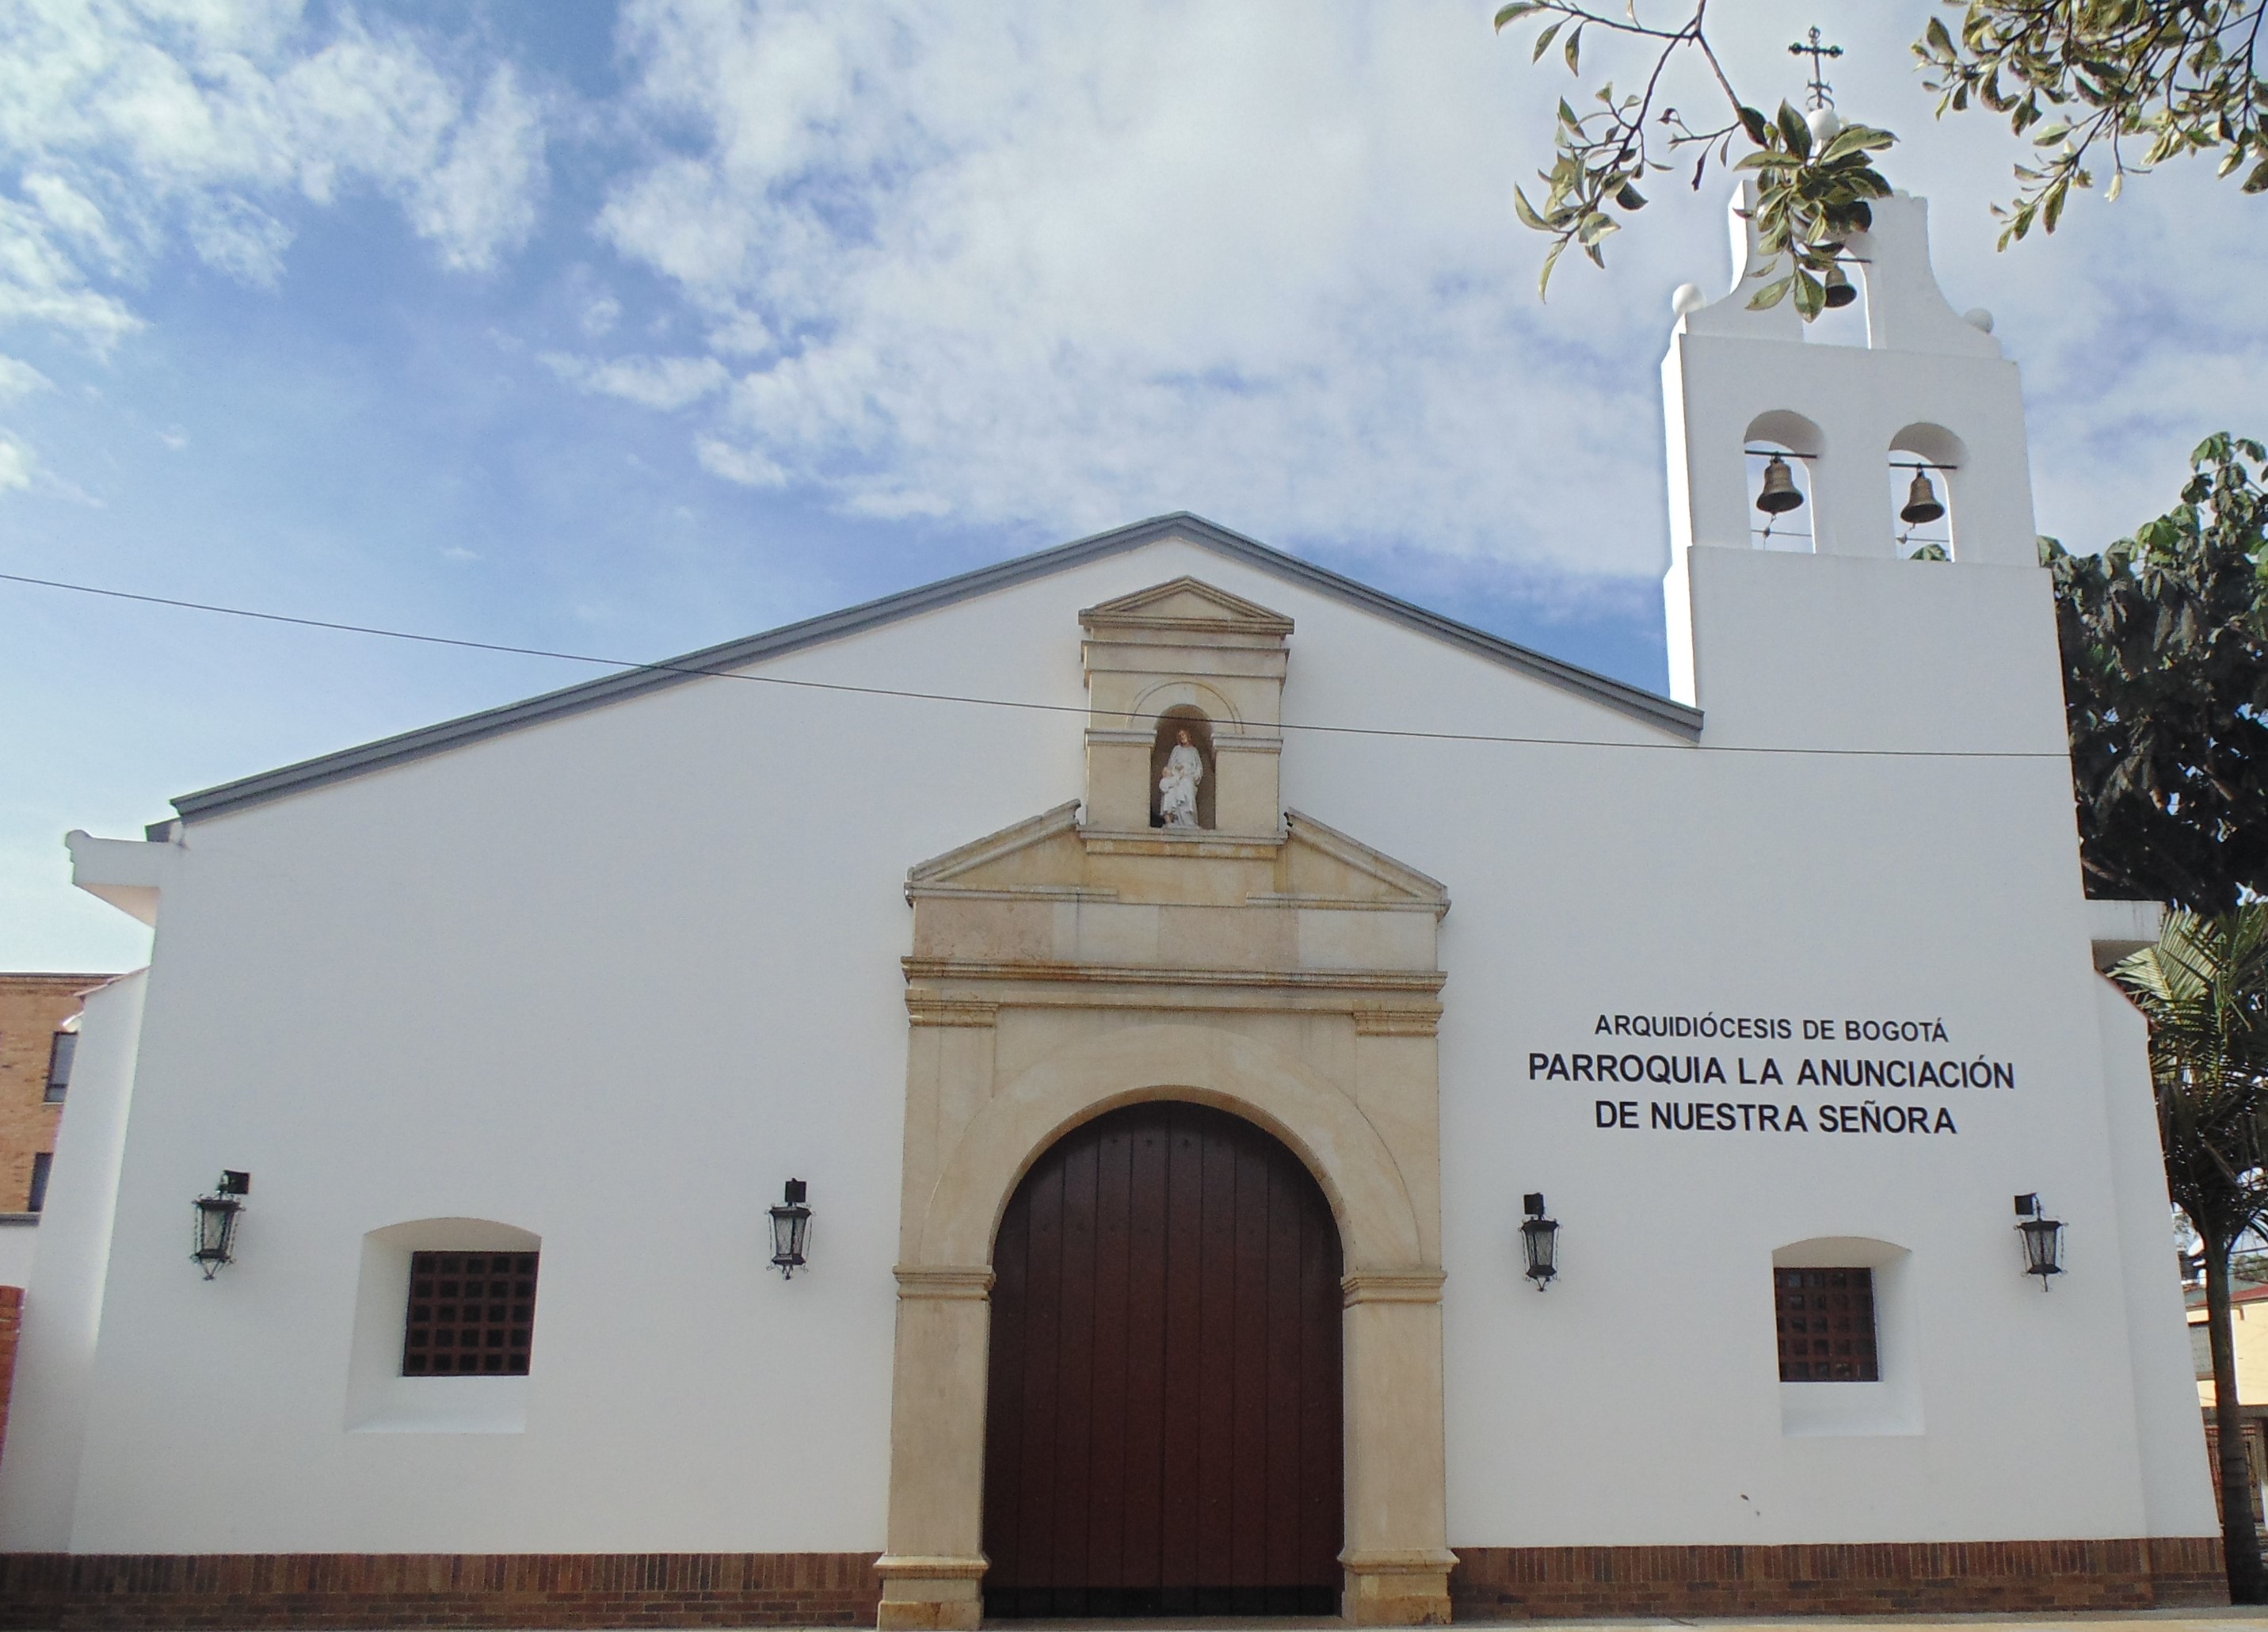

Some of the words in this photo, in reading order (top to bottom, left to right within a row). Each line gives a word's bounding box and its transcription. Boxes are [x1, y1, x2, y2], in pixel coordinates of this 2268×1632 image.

[1594, 1011, 1792, 1039] ARQUIDIÓCESIS
[1802, 1019, 1835, 1040] DE
[1845, 1017, 1950, 1043] BOGOTÁ
[1529, 1052, 1727, 1085] PARROQUIA
[1737, 1057, 1784, 1085] LA
[1797, 1054, 2015, 1089] ANUNCIACIÓN
[1595, 1100, 1640, 1129] DE
[1651, 1101, 1809, 1133] NUESTRA
[1818, 1100, 1957, 1134] SEÑORA
